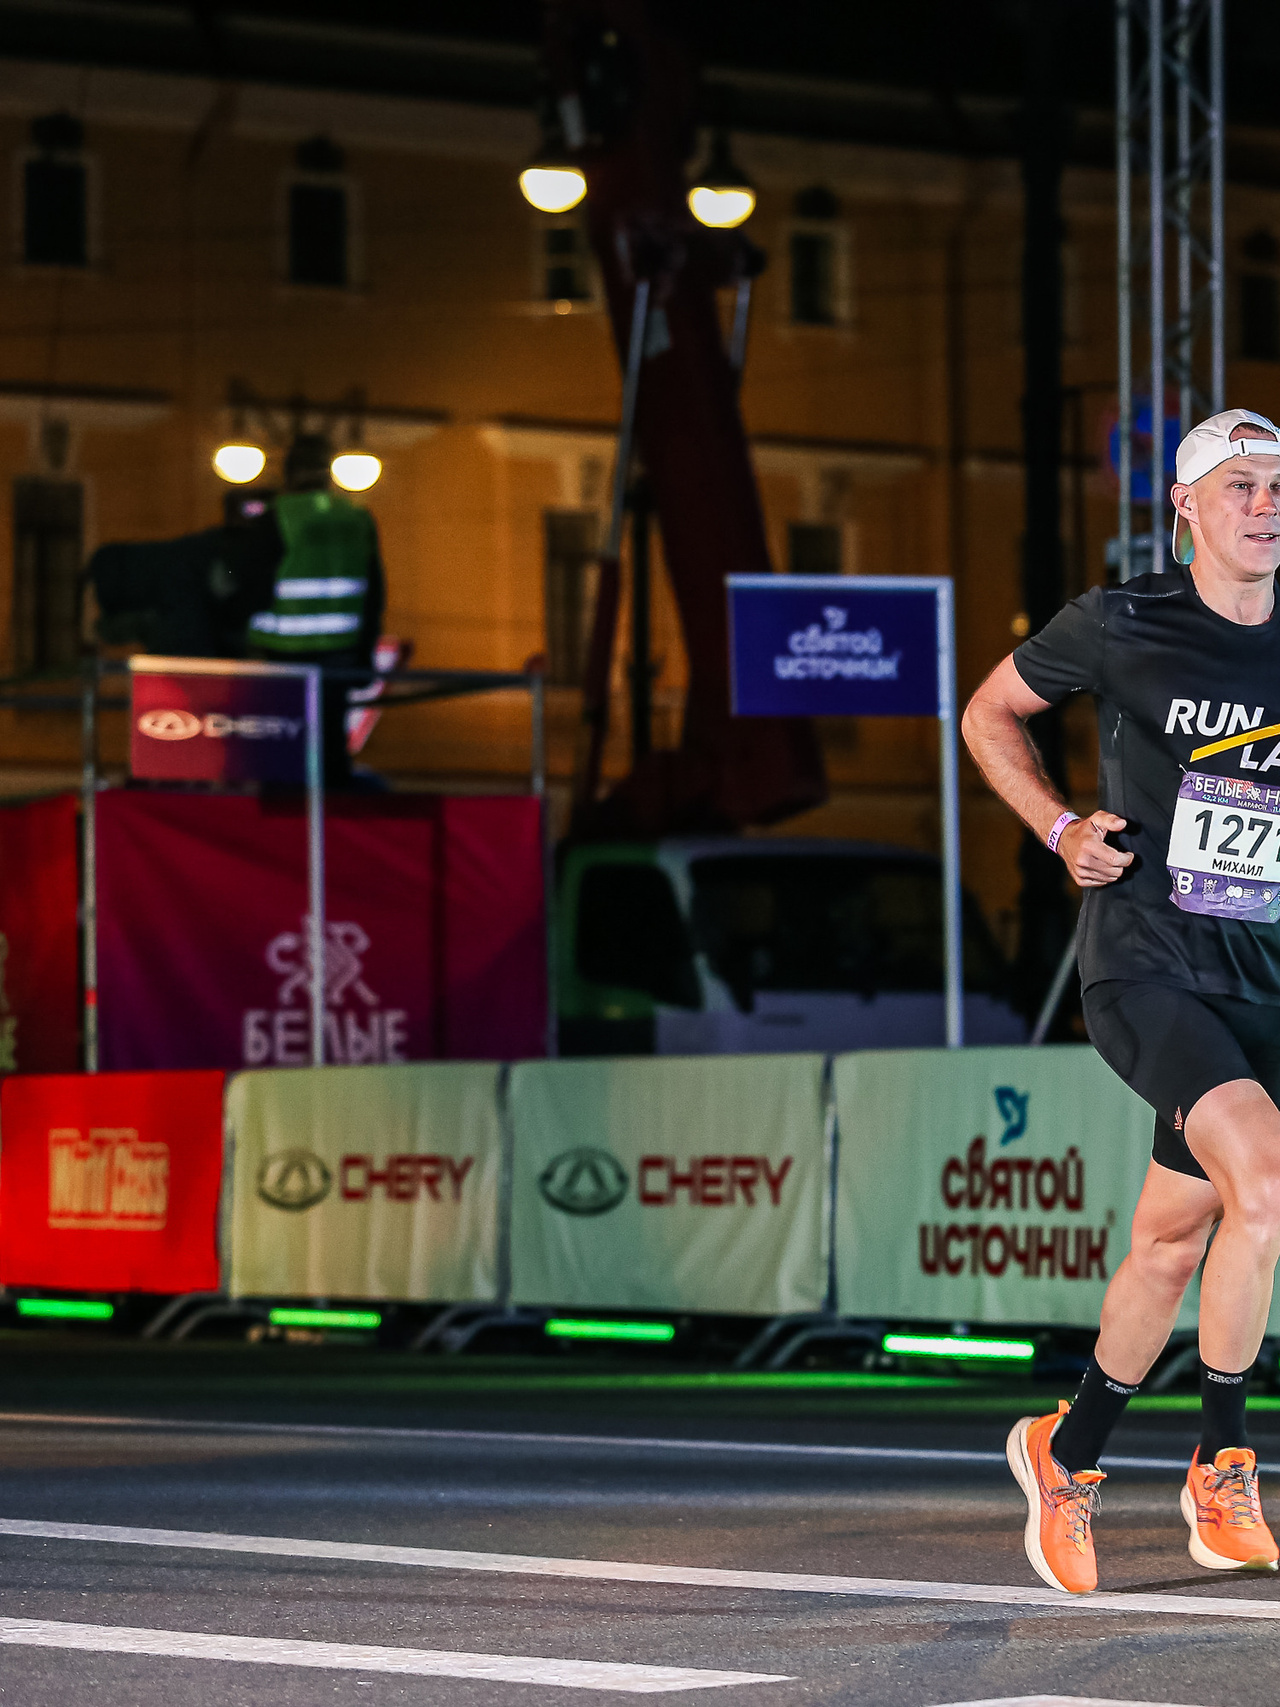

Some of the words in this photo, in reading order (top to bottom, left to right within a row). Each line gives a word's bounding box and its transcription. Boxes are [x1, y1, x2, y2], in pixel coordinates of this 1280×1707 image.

[1165, 699, 1264, 737] RUN
[1195, 777, 1244, 799] БЕЛЫЕ
[1212, 859, 1264, 877] МИХАИЛ
[341, 1154, 474, 1203] CHERY
[639, 1155, 793, 1207] CHERY
